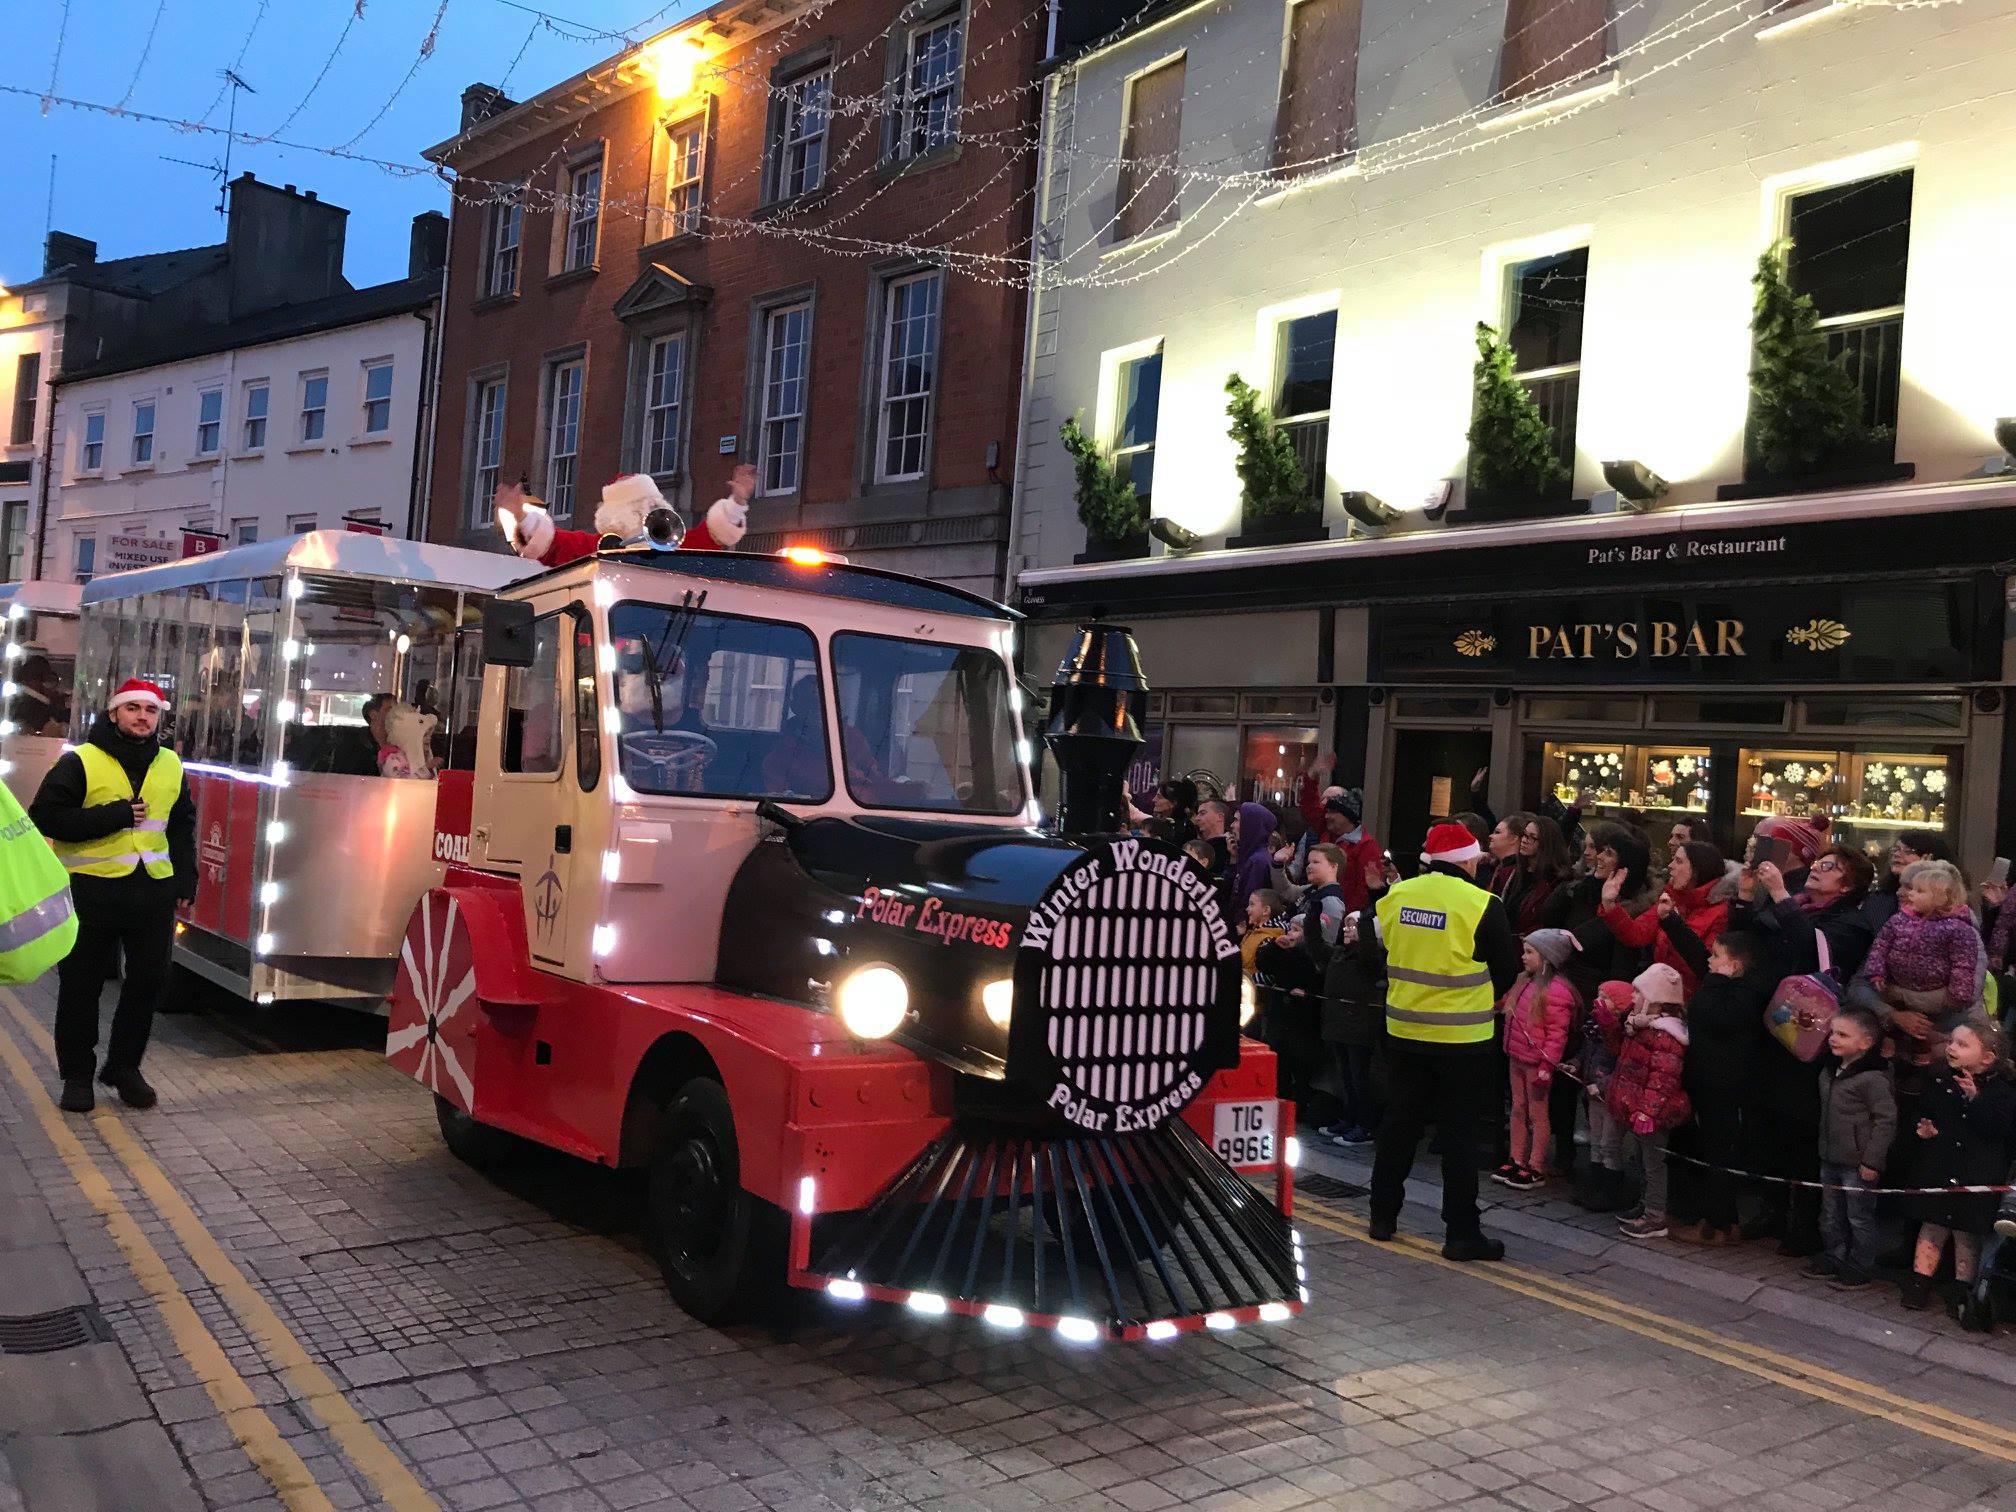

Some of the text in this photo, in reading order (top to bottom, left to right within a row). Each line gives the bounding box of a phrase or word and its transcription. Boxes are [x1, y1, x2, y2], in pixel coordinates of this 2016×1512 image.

[111, 536, 174, 552] FOR SALE
[115, 551, 169, 564] MIXED USE
[1588, 536, 1787, 564] Pat's Bar & Restaurant
[1650, 619, 1748, 657] BAR
[435, 832, 469, 863] COAL
[1019, 838, 1241, 961] Winter Wonderland
[856, 886, 1014, 949] Polar Express
[1401, 910, 1444, 927] SECURITY
[1047, 1071, 1202, 1132] Polar Express
[1232, 1105, 1263, 1132] TIG
